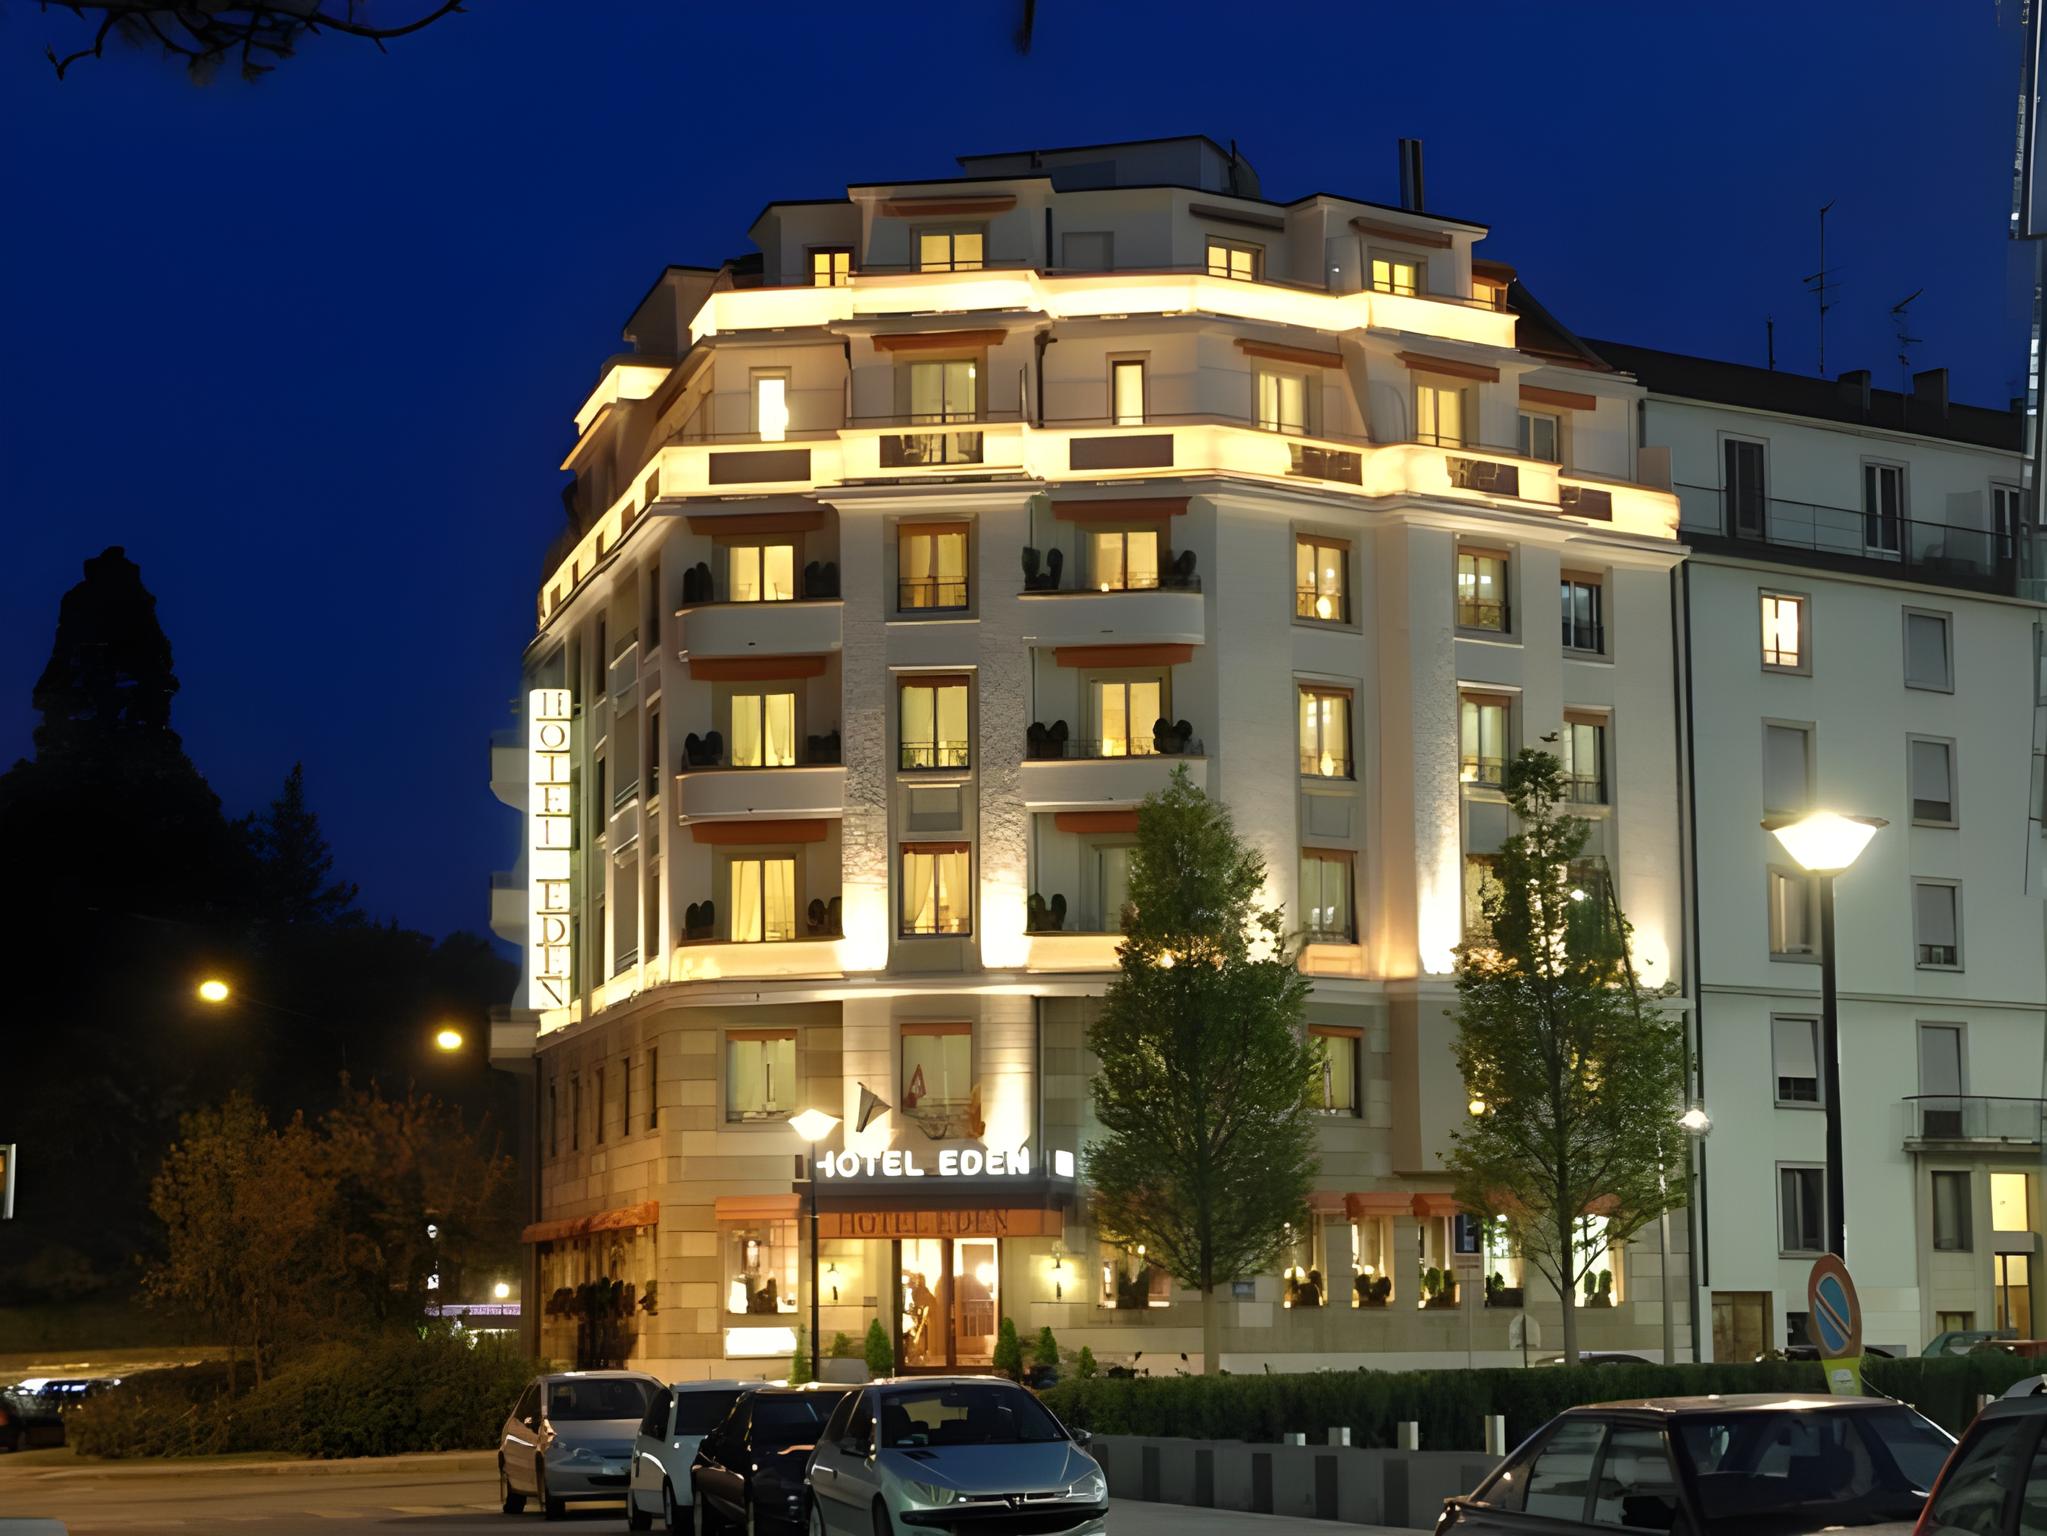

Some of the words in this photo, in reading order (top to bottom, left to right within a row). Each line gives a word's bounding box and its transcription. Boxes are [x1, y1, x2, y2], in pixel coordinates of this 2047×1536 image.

[540, 691, 566, 846] HOTEL
[815, 1149, 925, 1178] HOTEL
[938, 1145, 1030, 1176] EDEN
